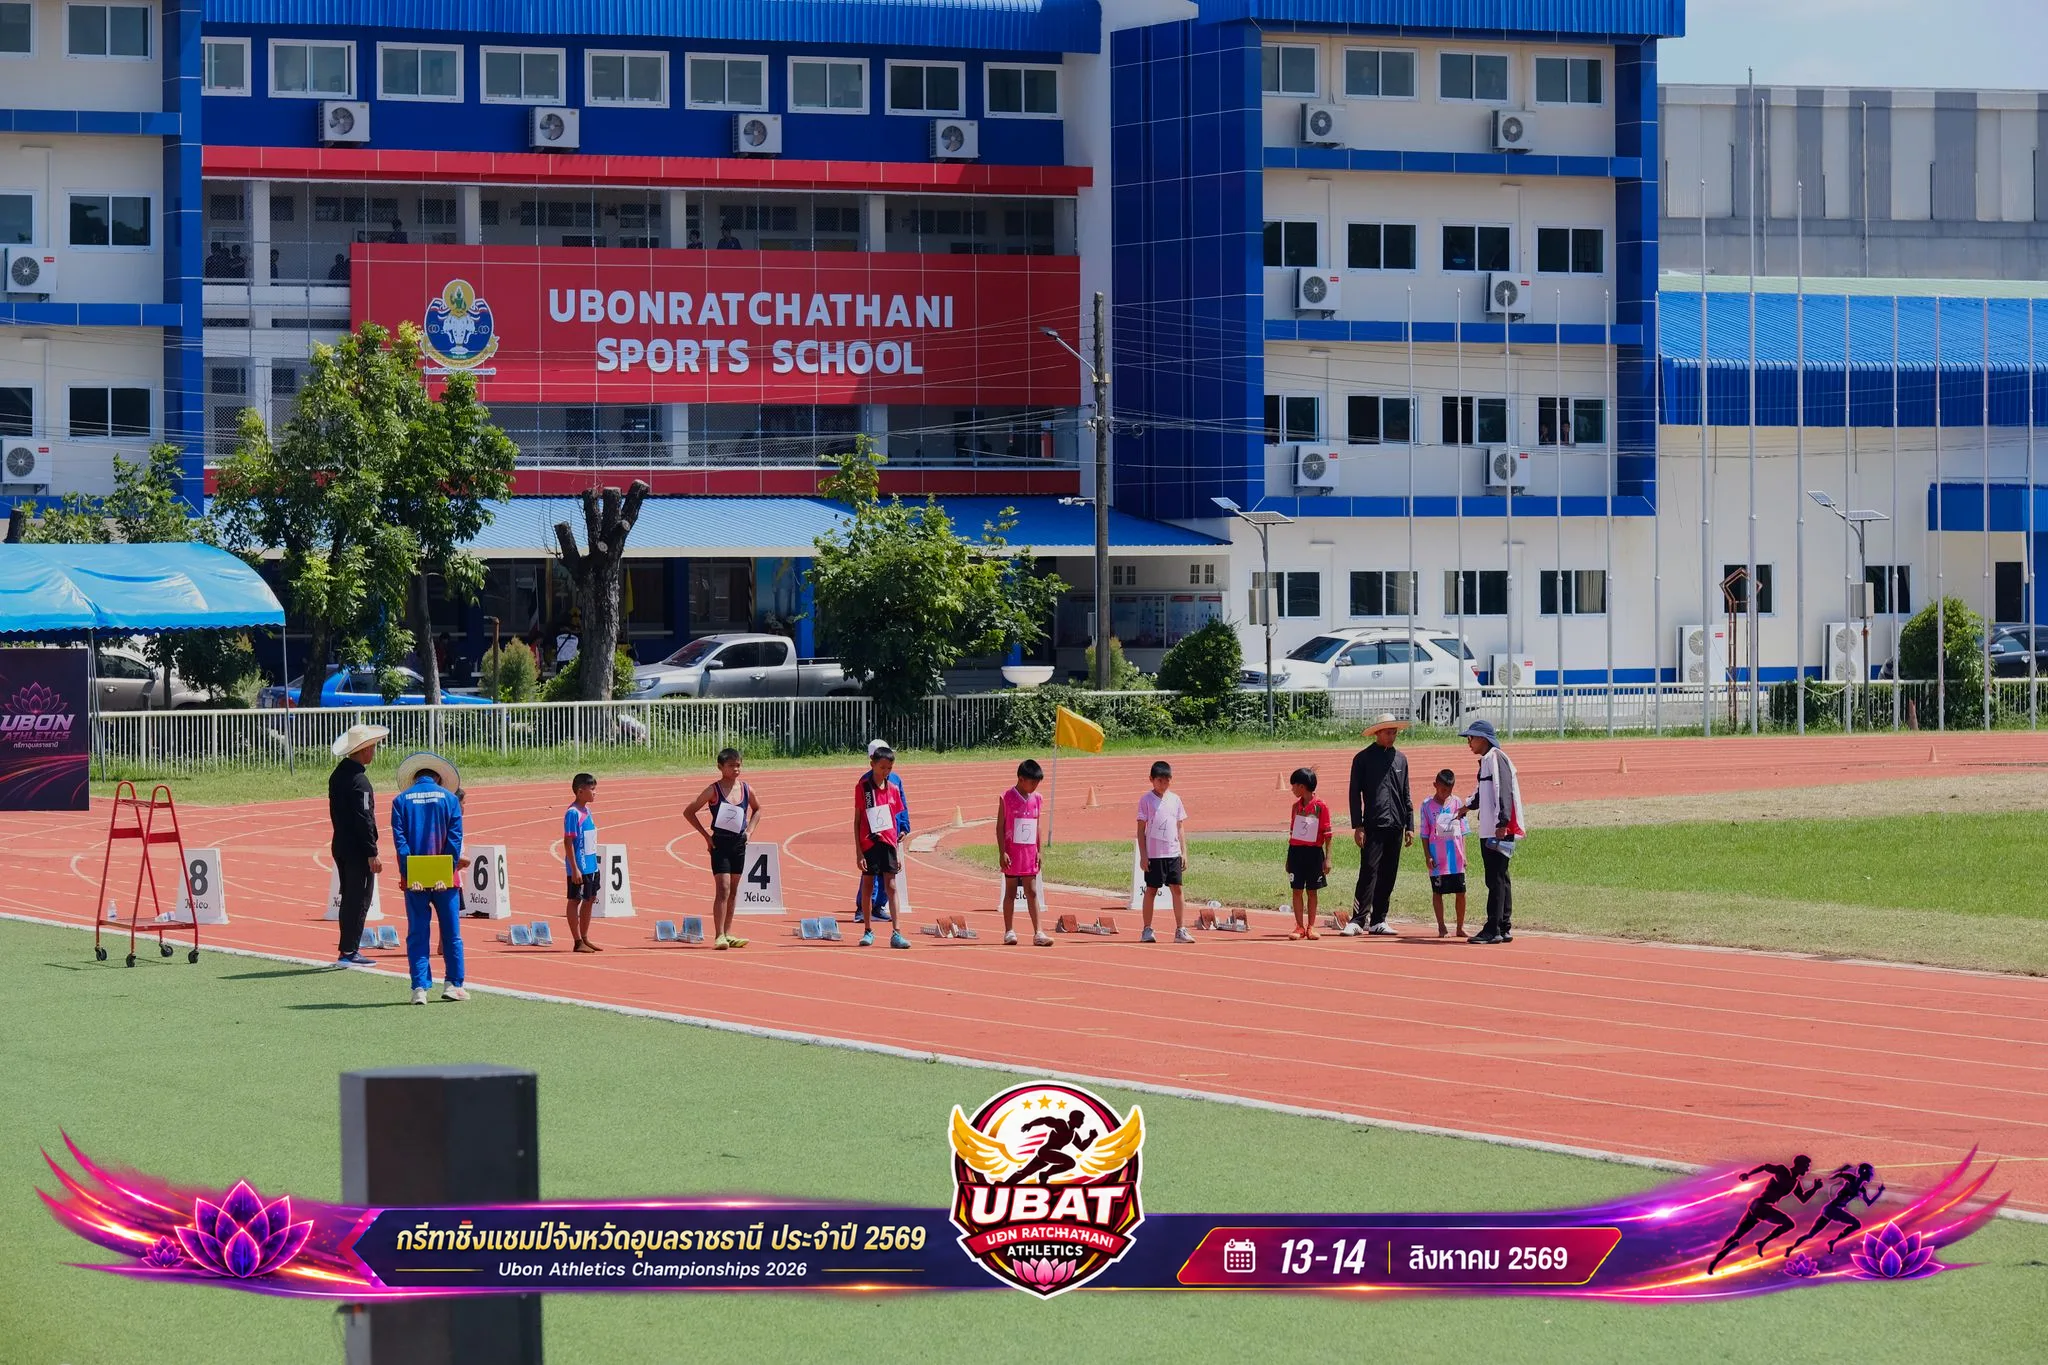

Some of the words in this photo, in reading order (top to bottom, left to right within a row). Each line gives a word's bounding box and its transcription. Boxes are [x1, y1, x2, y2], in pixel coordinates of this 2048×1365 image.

[549, 288, 954, 328] UBONRATCHATHANI
[596, 337, 750, 373] SPORTS
[772, 339, 924, 376] SCHOOL
[0, 714, 76, 731] UBON
[2, 731, 72, 740] ATHLETICS
[725, 808, 738, 824] 7
[876, 809, 885, 826] 6
[1021, 823, 1032, 842] 5
[1158, 818, 1169, 838] 4
[1300, 821, 1311, 836] 3
[189, 859, 209, 897] 8
[473, 854, 489, 891] 6
[497, 854, 505, 890] 6
[611, 855, 623, 891] 5
[747, 853, 771, 890] 4
[743, 891, 771, 903] Nelco
